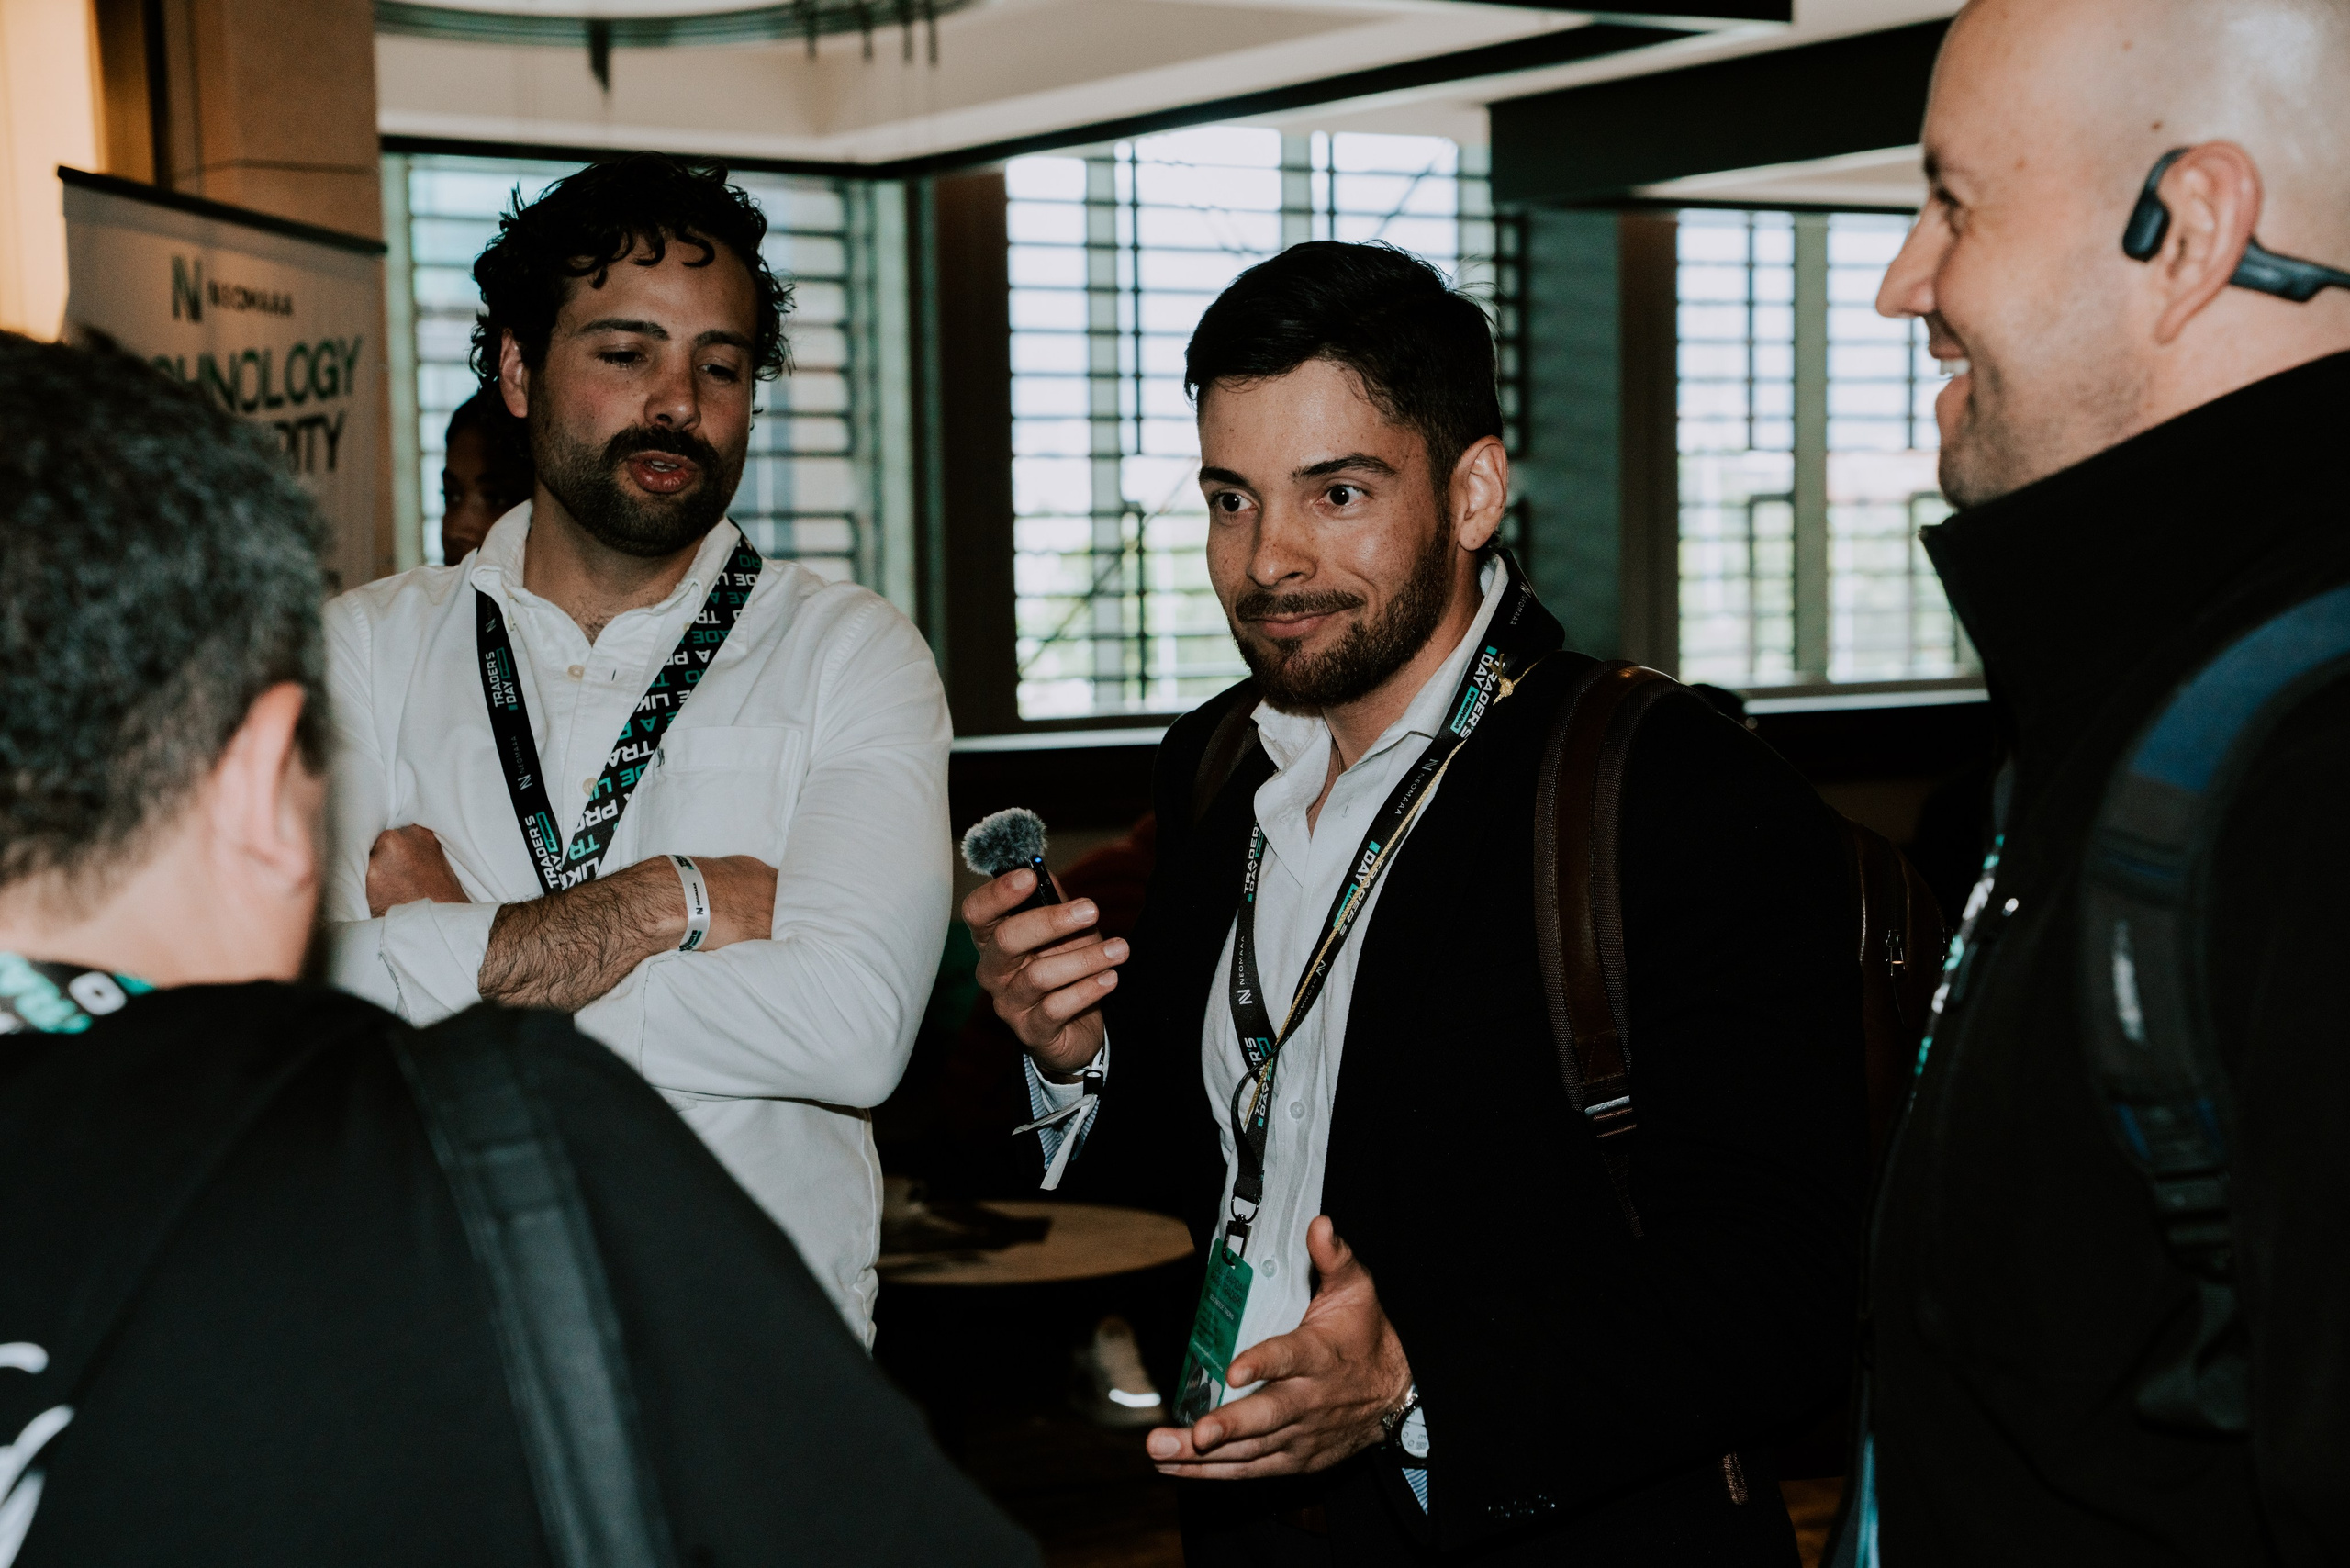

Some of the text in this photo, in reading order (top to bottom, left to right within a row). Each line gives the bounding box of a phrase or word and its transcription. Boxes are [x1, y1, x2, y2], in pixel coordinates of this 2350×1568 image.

[695, 649, 711, 663] A
[1473, 654, 1494, 689] DAY
[502, 681, 517, 704] DAY
[640, 716, 657, 732] A
[1394, 773, 1426, 815] NEOMAAA
[524, 815, 559, 889] TRADER'S
[1244, 820, 1260, 894] TRADER'
[1356, 850, 1376, 884] DAY
